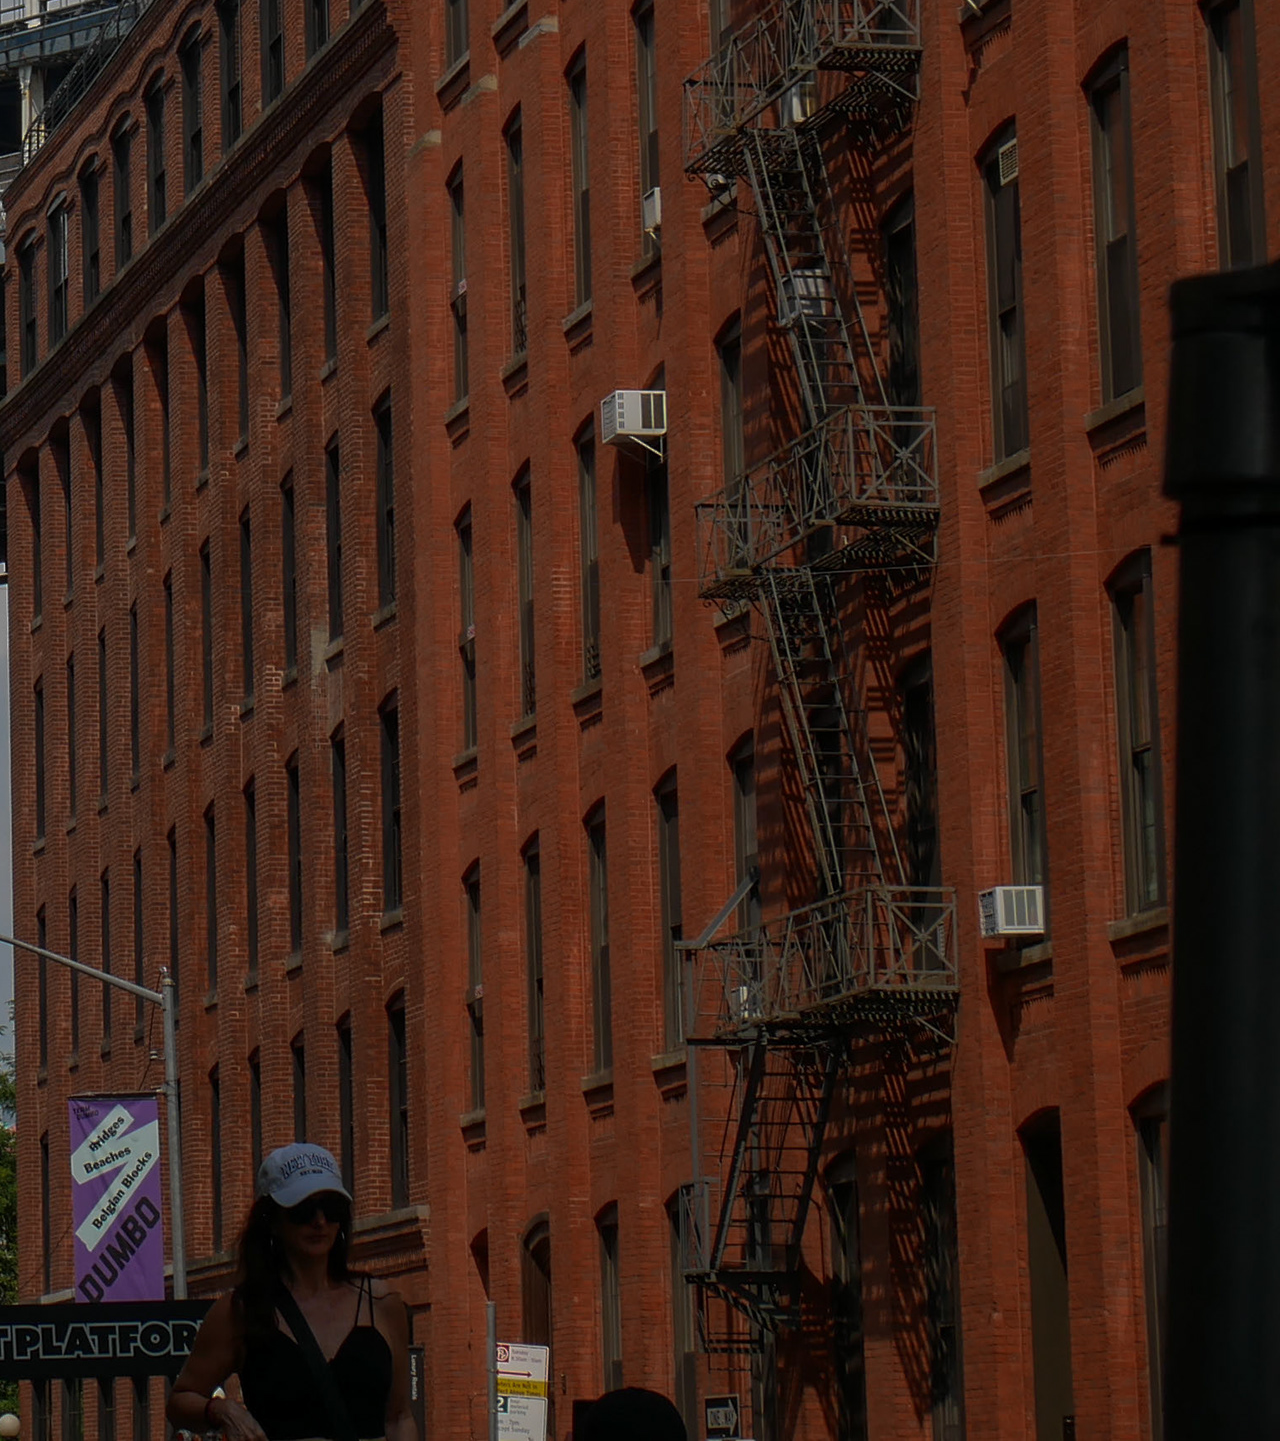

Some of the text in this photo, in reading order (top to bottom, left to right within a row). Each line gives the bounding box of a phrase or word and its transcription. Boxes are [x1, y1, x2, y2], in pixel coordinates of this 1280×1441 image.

[83, 1146, 131, 1174] Beaches
[89, 1116, 125, 1152] Bridges
[92, 1151, 152, 1230] Belgian Blocks
[78, 1196, 160, 1303] DUMBO
